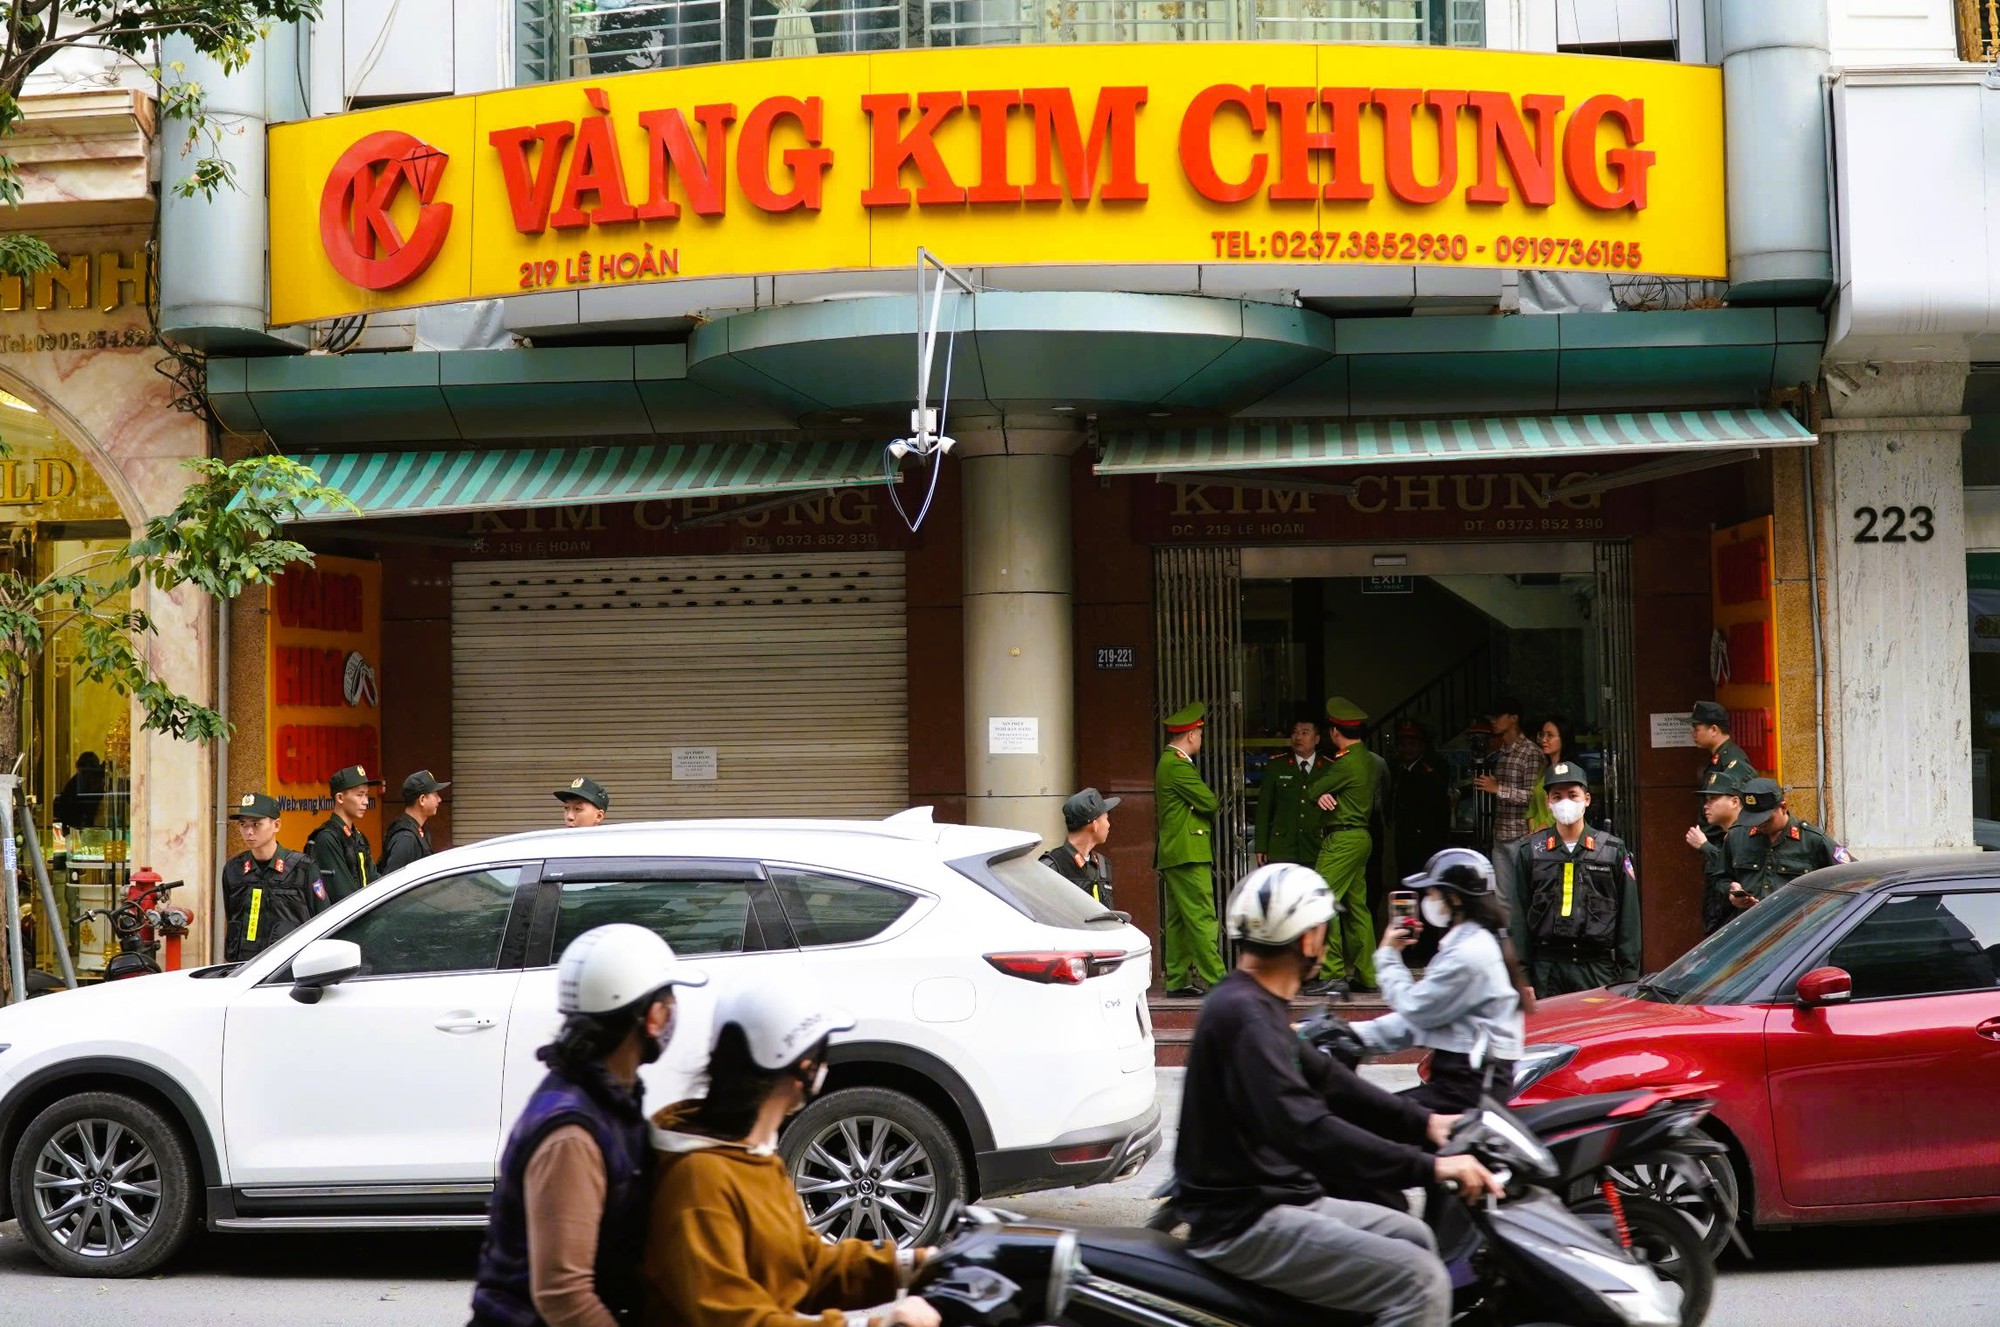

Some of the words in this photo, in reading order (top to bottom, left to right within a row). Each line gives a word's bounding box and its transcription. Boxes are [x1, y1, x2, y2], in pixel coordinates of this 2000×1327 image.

[489, 88, 833, 234] VÀNG
[861, 87, 1148, 210] KIM
[1178, 85, 1654, 214] CHUNG
[519, 260, 558, 288] 219
[566, 251, 591, 284] LÊ
[599, 243, 678, 281] HOÀN
[1497, 237, 1643, 268] 0919736185
[1170, 481, 1317, 516] KIM
[1347, 471, 1602, 513] CHUNG
[467, 505, 608, 534] KIM
[1853, 506, 1935, 545] 223
[1098, 648, 1132, 663] 219-221
